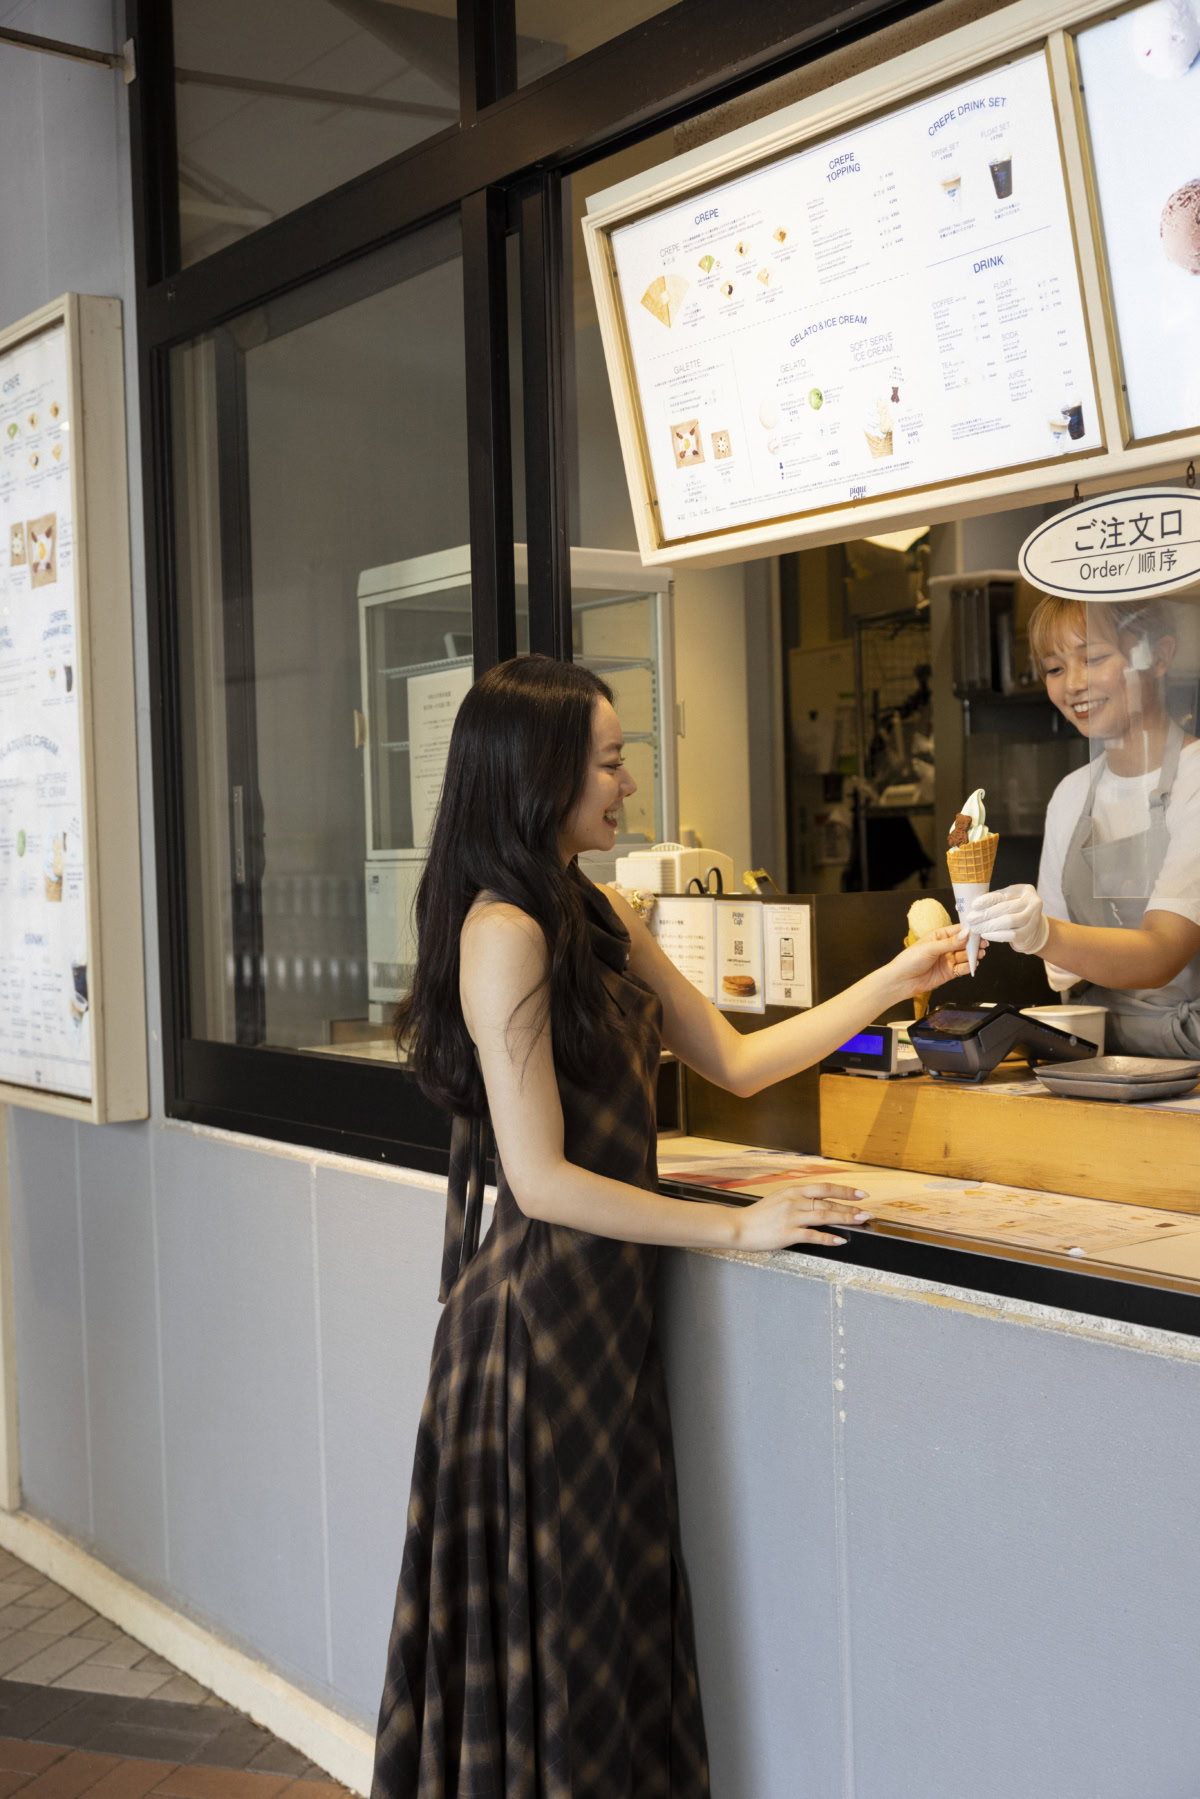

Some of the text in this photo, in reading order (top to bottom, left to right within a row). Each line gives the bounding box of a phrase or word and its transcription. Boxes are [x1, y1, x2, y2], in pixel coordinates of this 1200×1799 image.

[928, 96, 1007, 137] CREPE DRINK SET
[980, 121, 1010, 139] FLOAT SET
[931, 141, 960, 158] DRINK SET
[828, 152, 855, 170] CREPE
[826, 162, 861, 184] TOPPING
[694, 208, 719, 225] CREPE
[659, 242, 681, 258] CREPE
[972, 255, 1005, 274] DRINK
[993, 278, 1013, 290] FLOAT
[931, 296, 954, 310] COFFEE
[789, 314, 868, 348] GELATO & ICE CREAM
[1001, 330, 1019, 341] SODA
[849, 331, 894, 353] SOFT SERVE
[853, 343, 894, 362] ICE CREAM
[673, 358, 702, 375] GALETTE
[780, 358, 807, 374] GELATO
[941, 361, 953, 369] TEA
[1008, 369, 1025, 380] JUICE
[849, 485, 867, 498] pique
[1075, 509, 1182, 551] ご注文口
